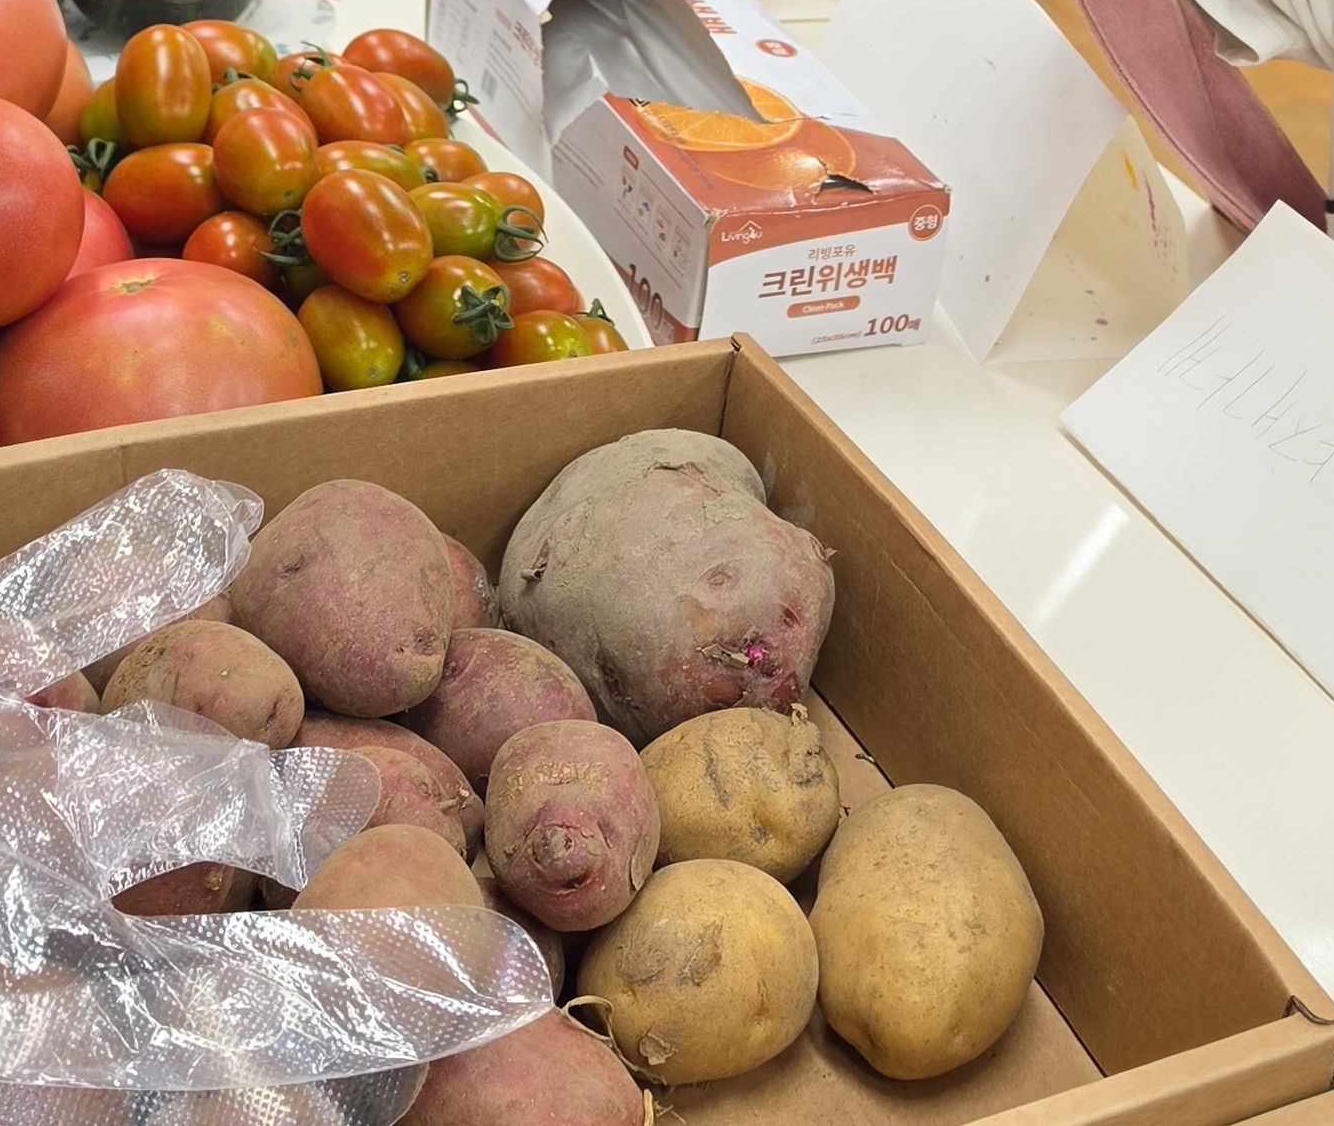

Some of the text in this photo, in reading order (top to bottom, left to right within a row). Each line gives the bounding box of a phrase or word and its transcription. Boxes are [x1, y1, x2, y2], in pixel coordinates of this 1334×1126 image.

[913, 214, 938, 232] 중형
[807, 243, 857, 262] 리빙포유
[757, 254, 899, 299] 크린위생백
